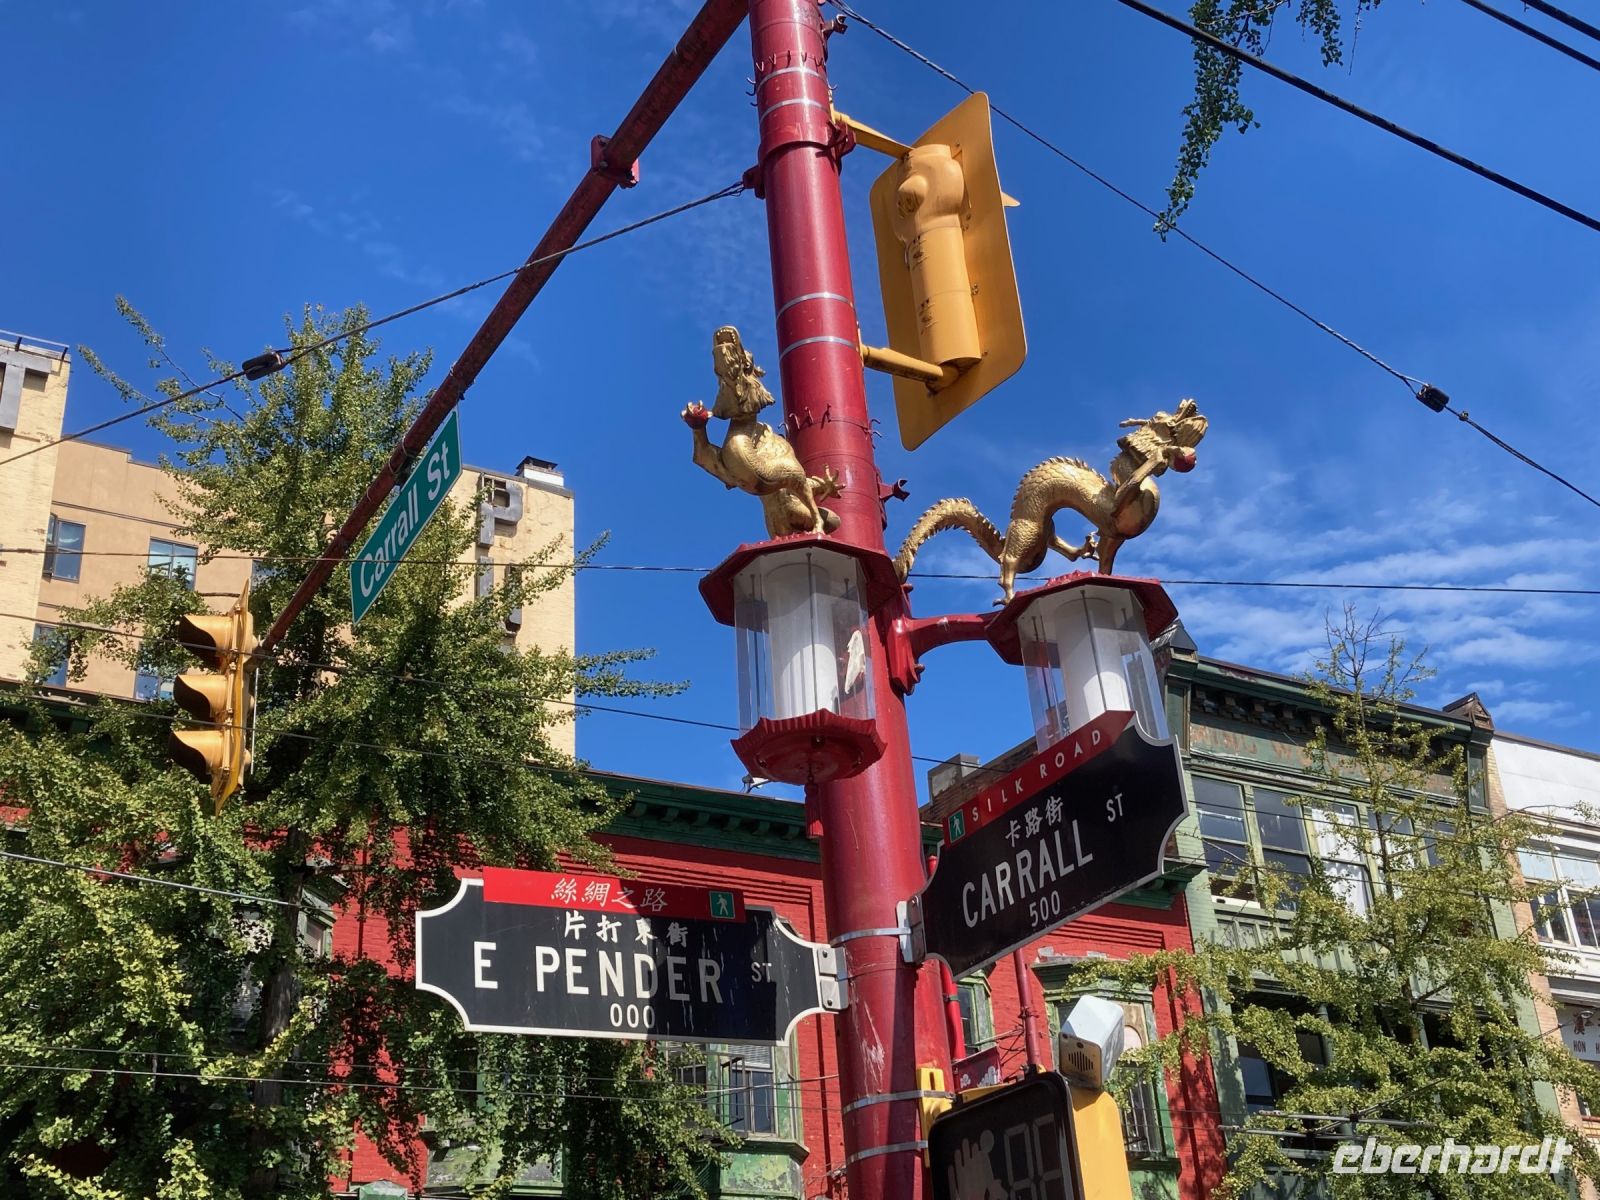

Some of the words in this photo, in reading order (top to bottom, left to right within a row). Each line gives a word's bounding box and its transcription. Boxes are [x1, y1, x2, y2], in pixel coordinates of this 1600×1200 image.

[360, 483, 419, 598] Carrall
[427, 441, 450, 501] St
[972, 779, 1023, 822] SILK
[1040, 729, 1100, 778] ROAD
[1005, 796, 1063, 847] 卡路街
[962, 819, 1093, 928] CARRALL
[1106, 793, 1123, 823] ST
[551, 877, 668, 912] 絲綢之路
[1029, 890, 1061, 928] 500
[564, 910, 689, 948] 片打東街
[473, 941, 498, 989] E
[536, 946, 724, 1004] PENDER
[751, 961, 772, 984] ST
